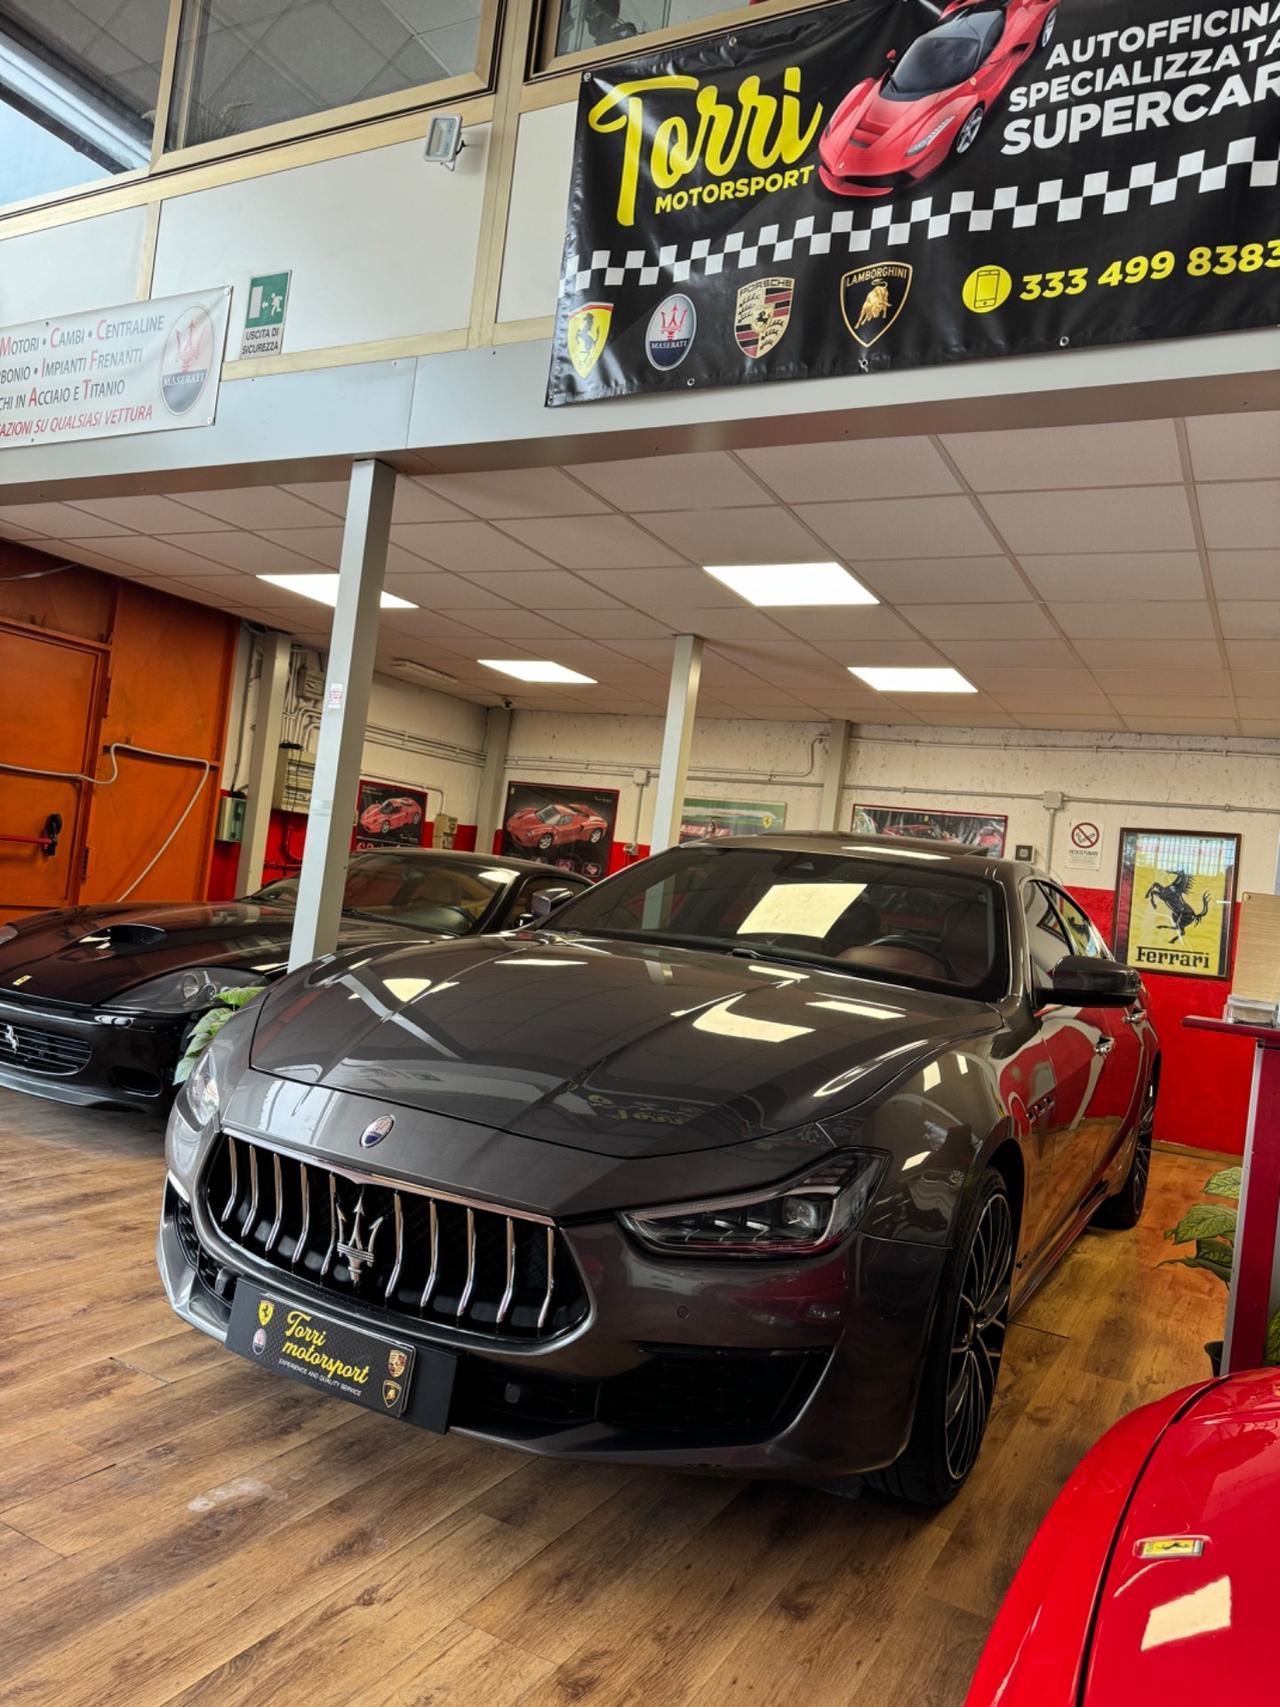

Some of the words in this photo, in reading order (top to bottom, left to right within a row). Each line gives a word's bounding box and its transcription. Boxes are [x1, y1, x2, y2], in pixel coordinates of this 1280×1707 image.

[1008, 28, 1280, 112] SPECIALIZZATA
[1001, 60, 1280, 155] SUPERCAR
[588, 67, 823, 226] Torri
[655, 165, 815, 214] MOTORSPORT
[845, 265, 908, 288] LAMBORGHINI
[1019, 268, 1089, 300] 333
[1097, 250, 1176, 287] 499
[1186, 238, 1280, 277] 8383
[739, 278, 793, 296] PORSCHE
[0, 336, 40, 357] MOTORI
[50, 327, 85, 348] CAMBI
[96, 315, 165, 341] CENTRALINE
[242, 341, 279, 355] SICUREZZA
[245, 328, 270, 341] USCITA
[271, 327, 280, 337] DI
[0, 366, 31, 384] BONIO
[41, 358, 87, 378] IMPIANTI
[90, 348, 144, 370] FRENANTI
[15, 394, 26, 408] IN
[28, 387, 71, 408] ACCIAIO
[74, 386, 80, 401] E
[82, 379, 126, 400] TITANIO
[0, 420, 34, 437] AZIONI
[34, 418, 49, 433] SU
[50, 411, 104, 432] QUALSIASI
[105, 404, 153, 425] VETTURA
[1136, 946, 1210, 968] Ferrari
[285, 1311, 327, 1346] Torri
[281, 1341, 370, 1384] motorsport
[307, 1370, 320, 1380] AND
